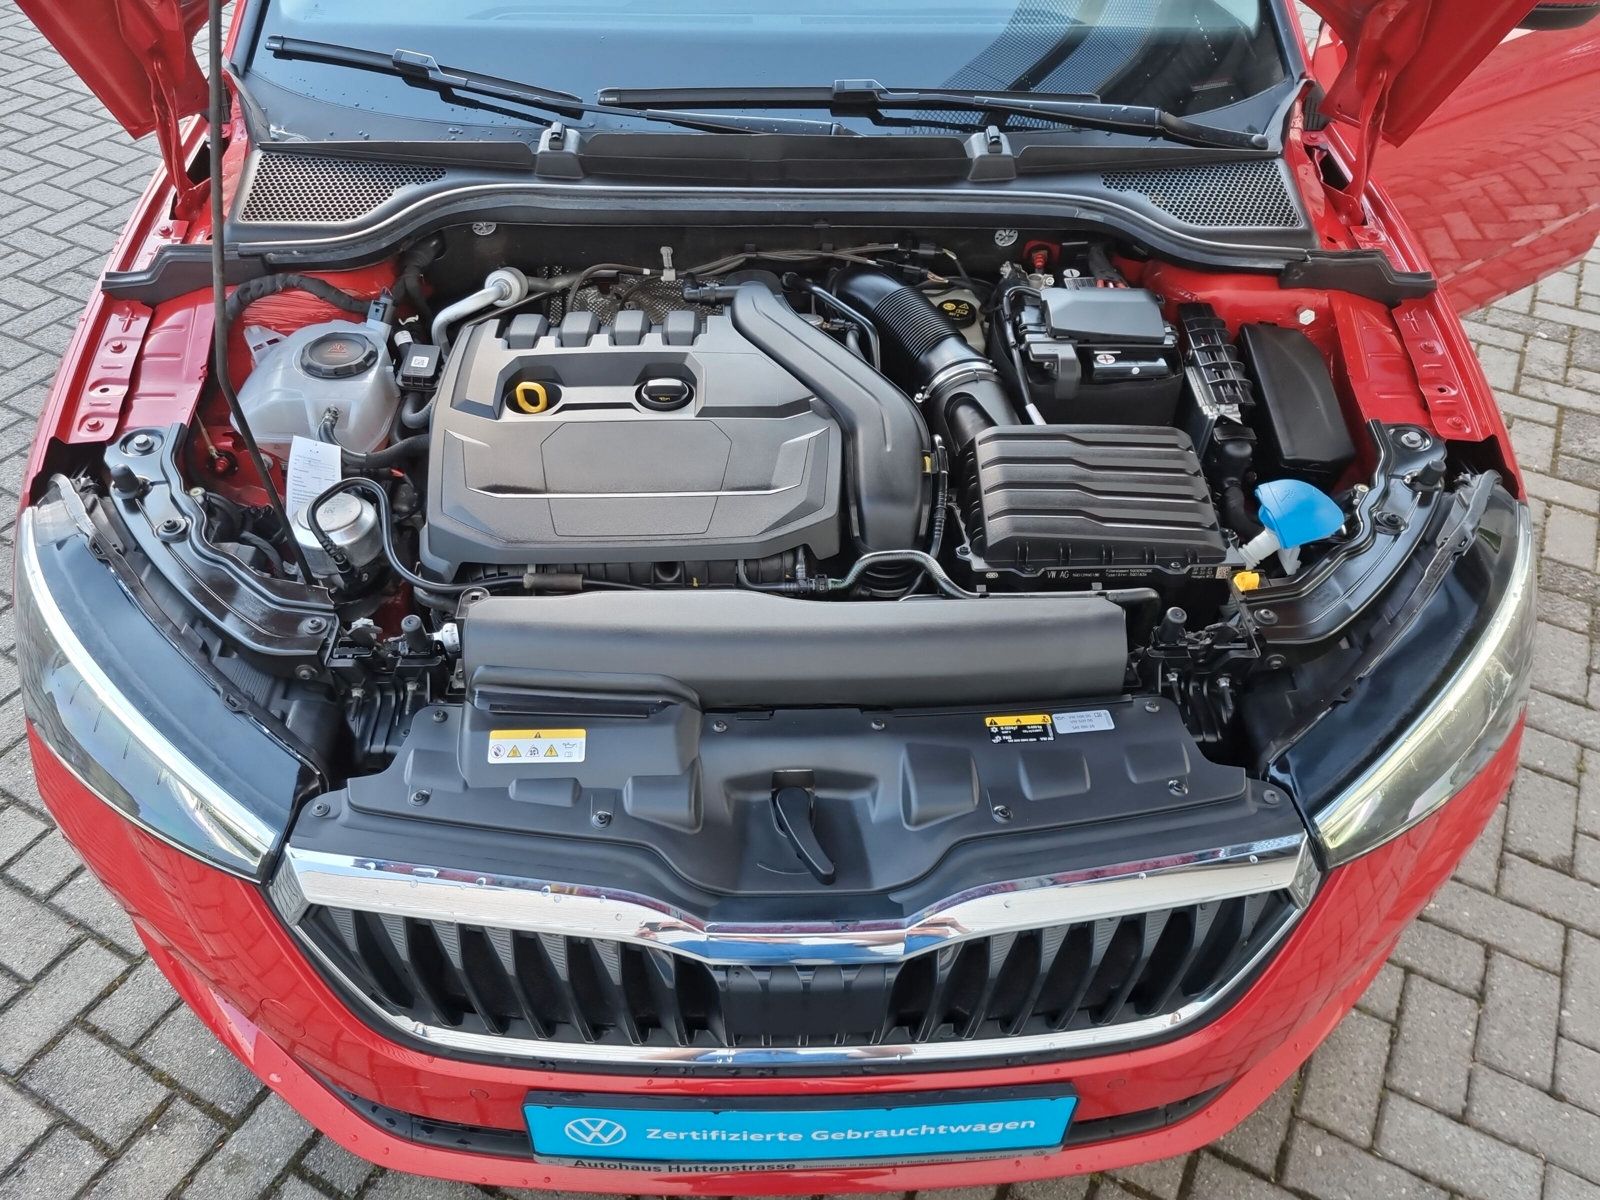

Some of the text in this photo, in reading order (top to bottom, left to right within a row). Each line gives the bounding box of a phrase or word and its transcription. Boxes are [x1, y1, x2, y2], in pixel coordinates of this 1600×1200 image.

[1046, 570, 1057, 579] VW
[1060, 570, 1070, 579] AG
[646, 1119, 1036, 1142] Zertifizierte Gebrauchtwagen
[574, 1159, 796, 1173] Autohaus Huttenstrasse
